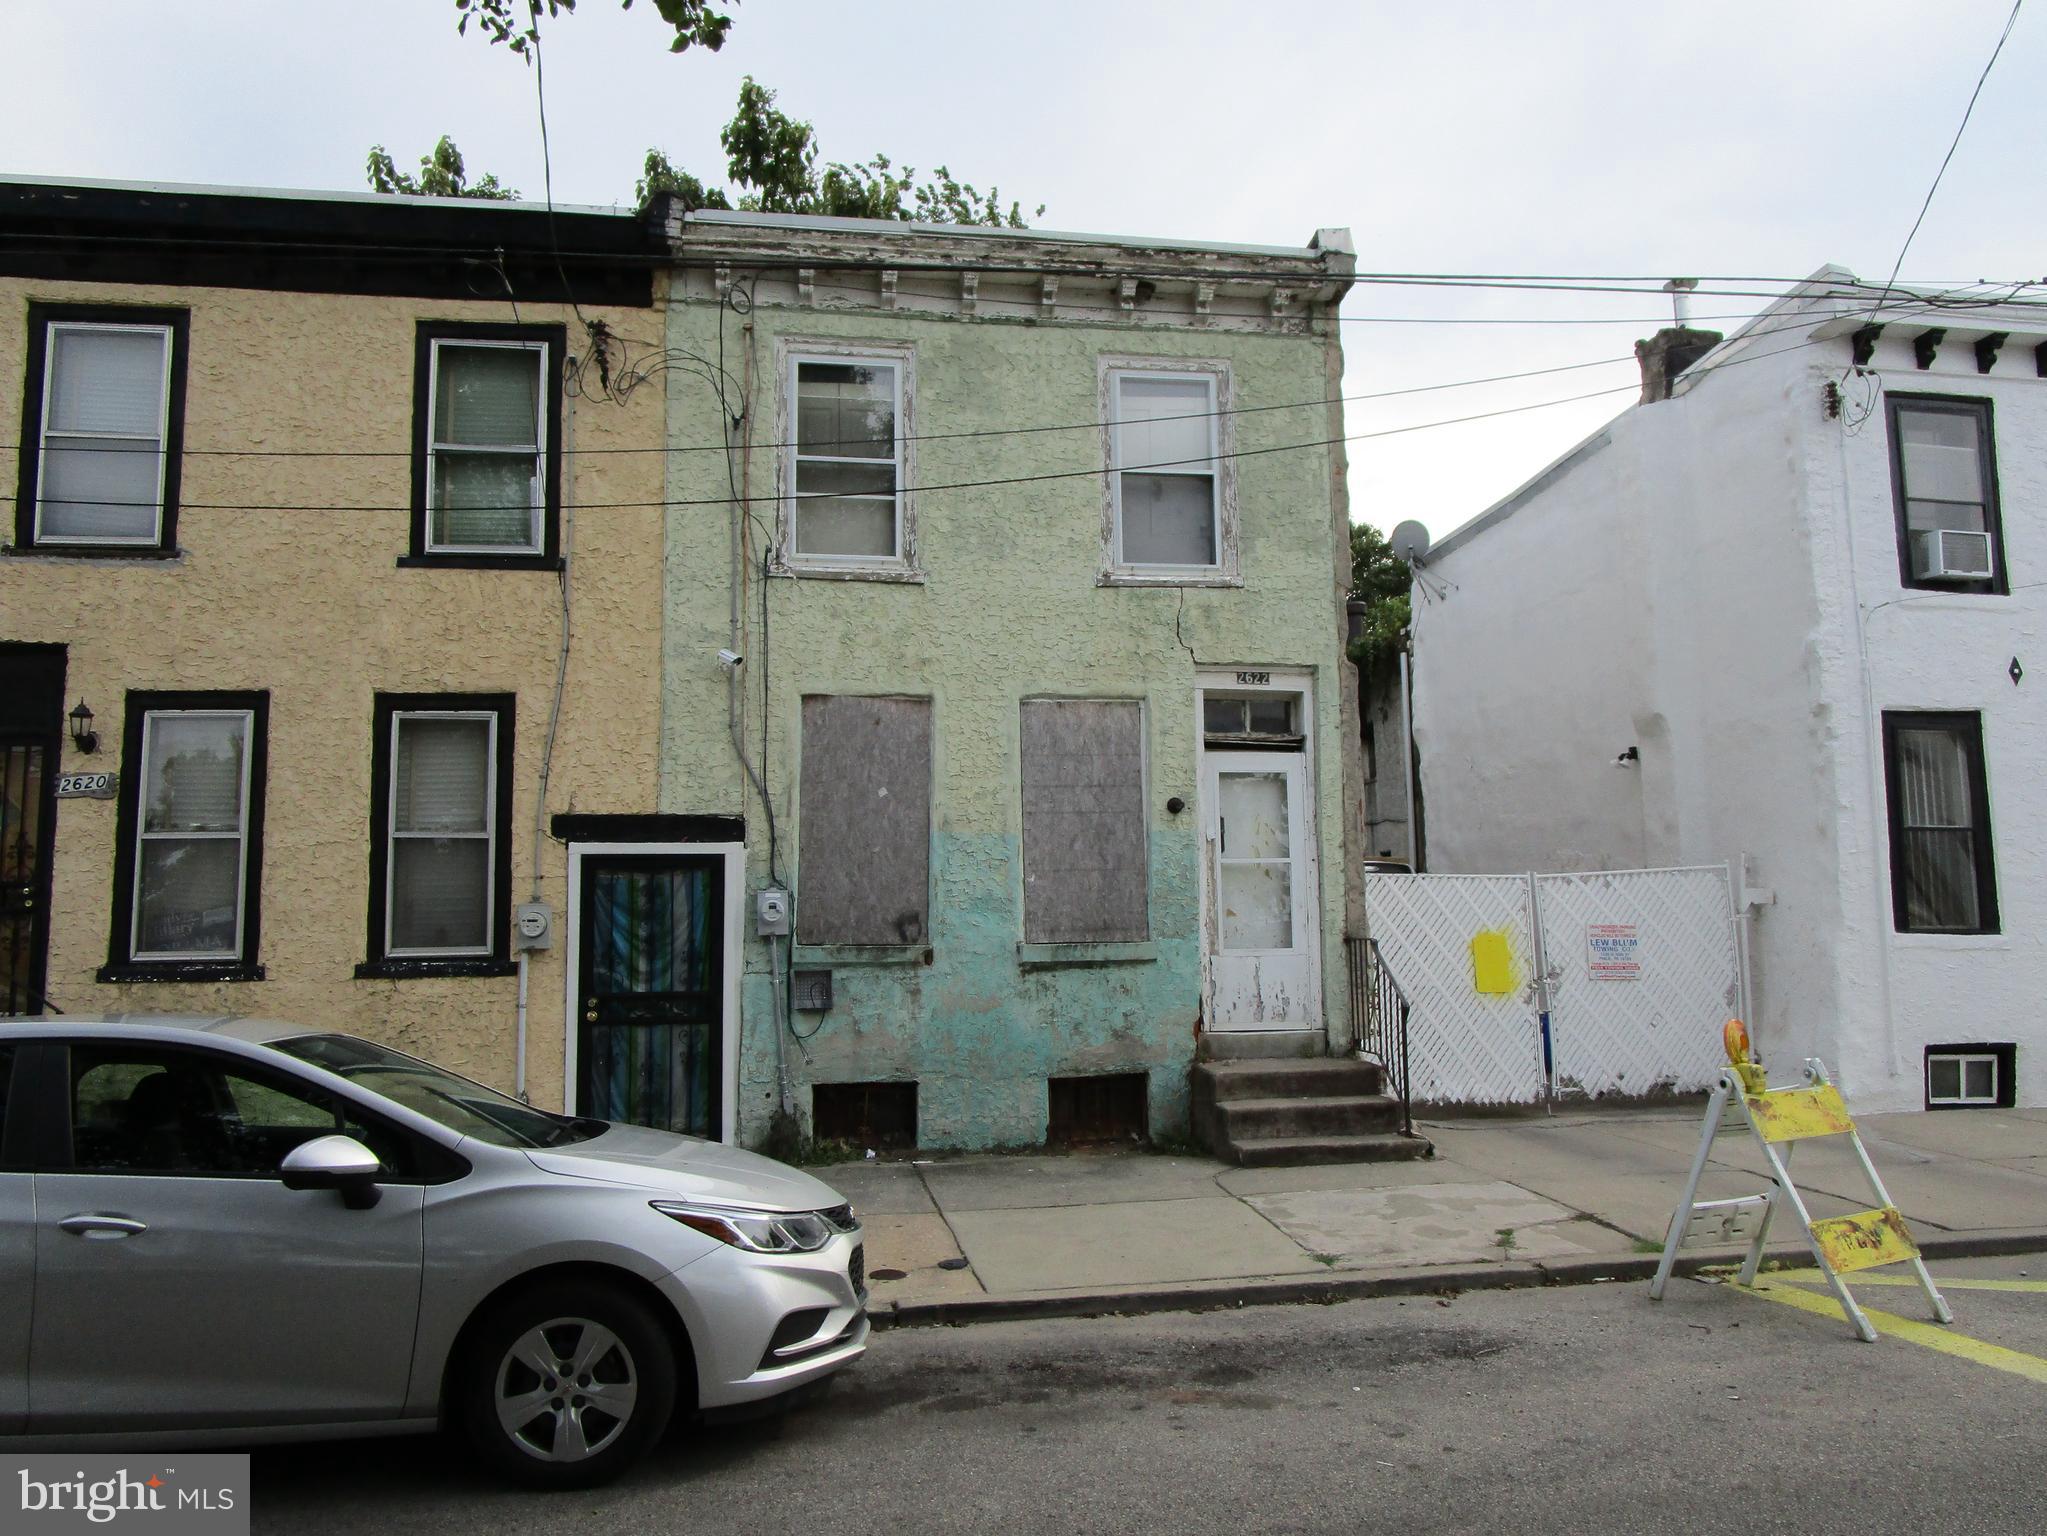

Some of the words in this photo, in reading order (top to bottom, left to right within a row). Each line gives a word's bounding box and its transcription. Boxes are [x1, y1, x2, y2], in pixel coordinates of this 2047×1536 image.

[1238, 672, 1269, 685] 2622
[61, 775, 107, 792] 2620
[1612, 938, 1638, 946] BLUM
